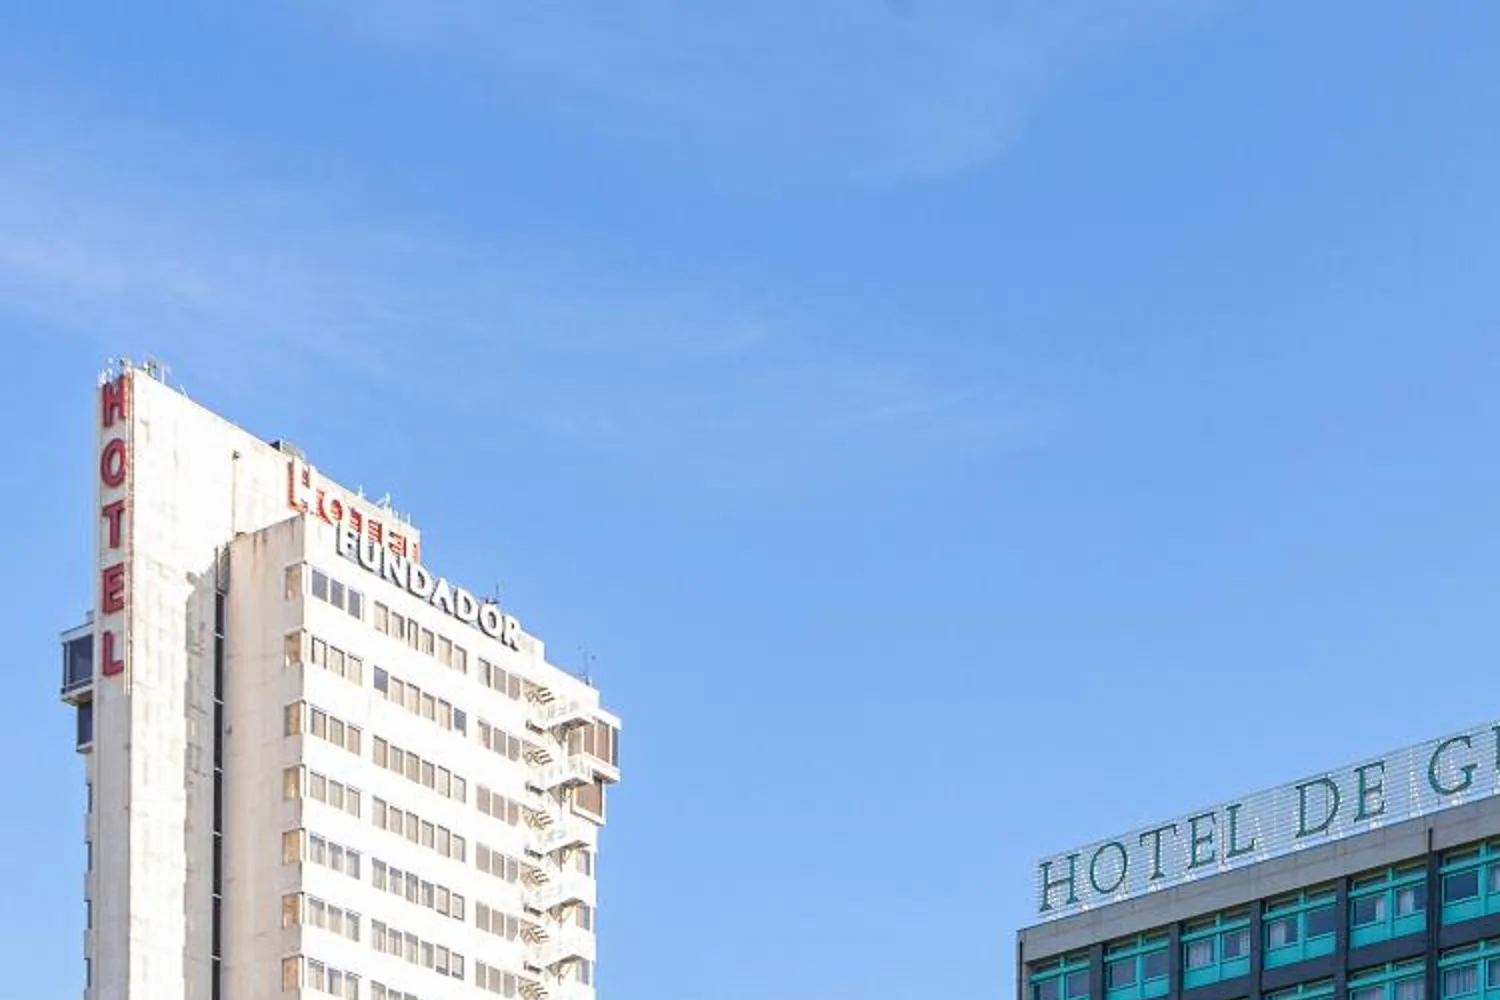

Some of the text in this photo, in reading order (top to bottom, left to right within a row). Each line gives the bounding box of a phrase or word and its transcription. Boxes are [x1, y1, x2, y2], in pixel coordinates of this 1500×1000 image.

[101, 374, 127, 677] HOTEL
[336, 520, 520, 652] FUNDADOR
[1039, 803, 1255, 913] HOTEL
[1296, 760, 1386, 838] DE
